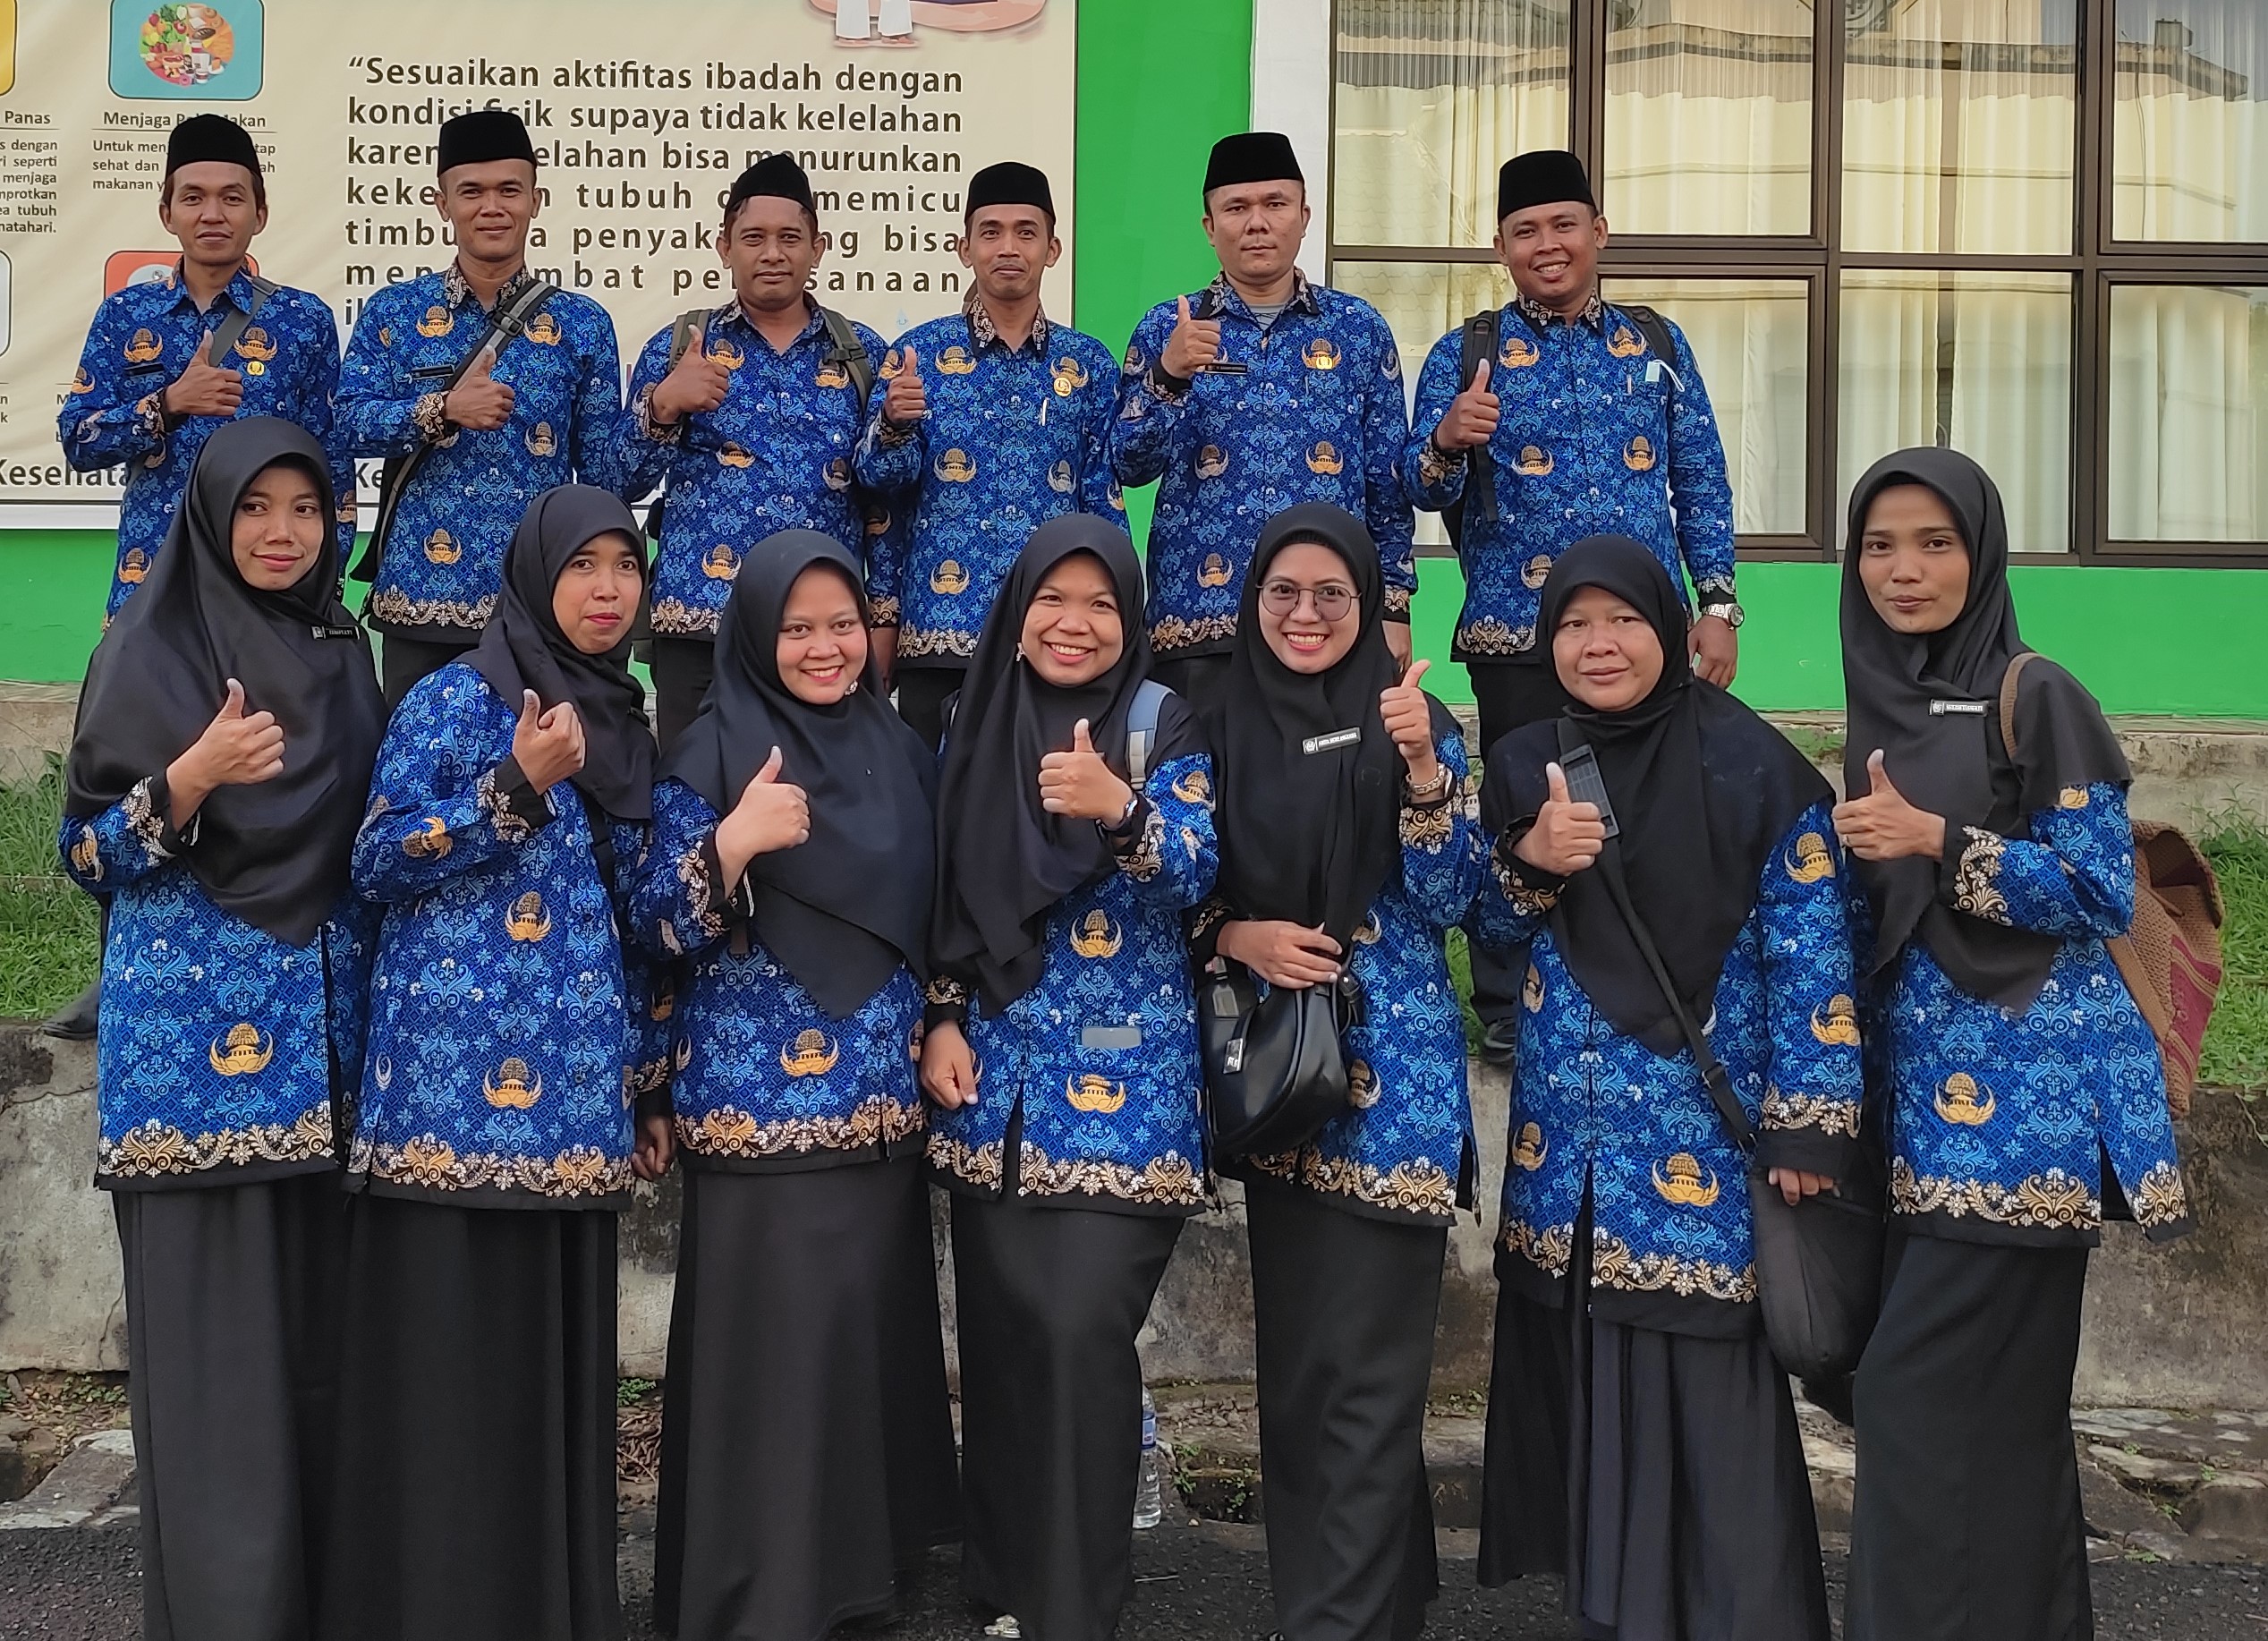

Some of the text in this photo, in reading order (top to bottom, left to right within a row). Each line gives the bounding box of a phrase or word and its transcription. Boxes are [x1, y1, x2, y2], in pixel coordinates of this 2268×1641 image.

[553, 59, 692, 89] aktifitas
[706, 62, 821, 90] ibadah
[835, 63, 962, 99] dengan
[4, 110, 51, 124] Panas
[104, 111, 171, 129] Menjaga
[570, 107, 689, 137] supaya
[700, 102, 788, 131] tidak
[797, 102, 961, 132] kelelahan
[11, 139, 58, 153] dengan
[93, 140, 134, 152] Untuk
[346, 136, 438, 166] karen
[535, 140, 646, 168] elahan
[662, 140, 729, 170] bisa
[13, 157, 57, 169] seperti
[92, 158, 159, 172] sehat dan
[3, 171, 57, 186] menjaga
[92, 177, 153, 190] makanan
[576, 180, 692, 209] tubuh
[17, 204, 57, 217] tubuh
[0, 220, 57, 233] atahari.
[881, 222, 961, 253] bisa
